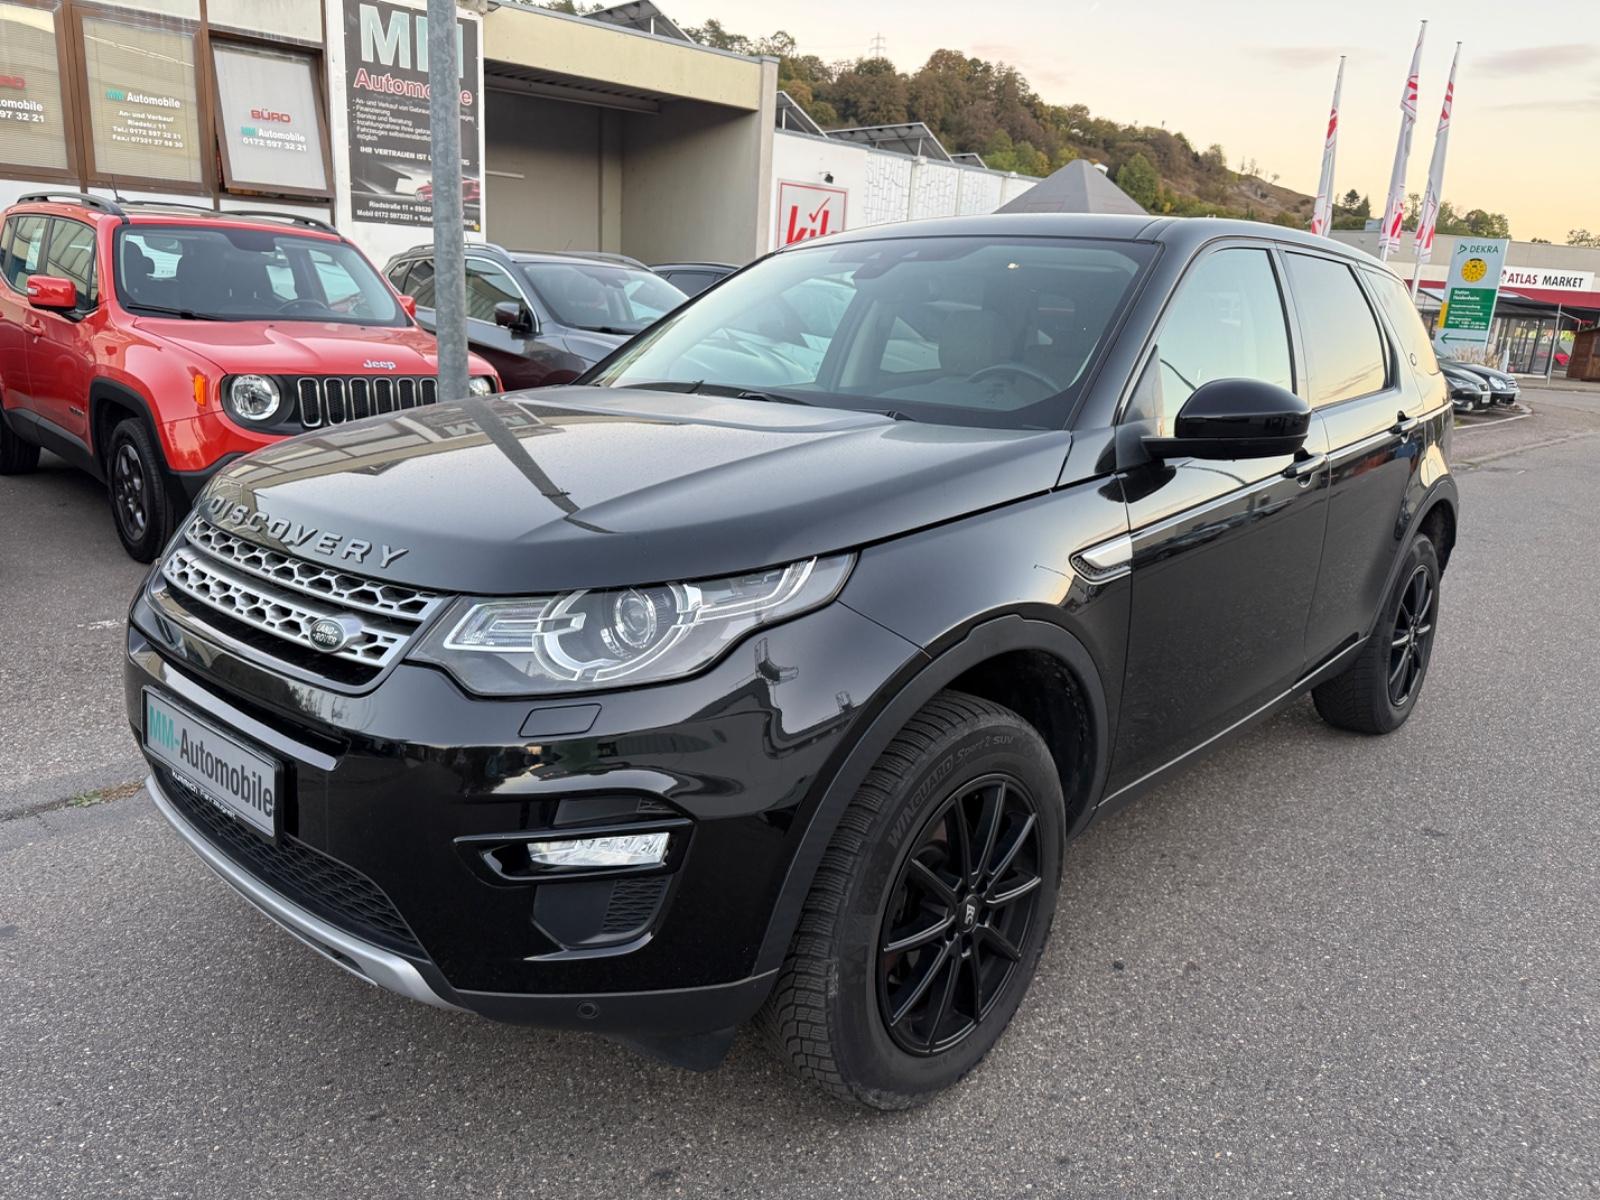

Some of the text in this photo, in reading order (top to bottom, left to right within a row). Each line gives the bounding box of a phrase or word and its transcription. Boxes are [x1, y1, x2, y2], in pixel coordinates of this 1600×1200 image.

[0, 98, 43, 111] omobile
[127, 91, 181, 108] Automobile
[16, 111, 29, 120] 32
[32, 113, 45, 123] 21
[250, 108, 291, 123] BÜRO
[258, 128, 306, 143] Automobile
[242, 137, 265, 146] 0172
[284, 142, 295, 150] 32
[296, 144, 307, 152] 21
[360, 145, 372, 153] IHR
[373, 147, 415, 159] VERTRAUEN
[416, 152, 426, 160] IST
[368, 200, 401, 211] Riedstraße
[356, 209, 374, 218] Mobil
[374, 210, 389, 219] 0172
[1469, 245, 1499, 254] DEKRA
[1507, 272, 1584, 288] ATLAS MARKET
[363, 359, 396, 370] Jeep
[208, 494, 409, 569] DISCOVERY
[887, 754, 953, 849] WINGUARD
[993, 735, 1015, 745] SUV
